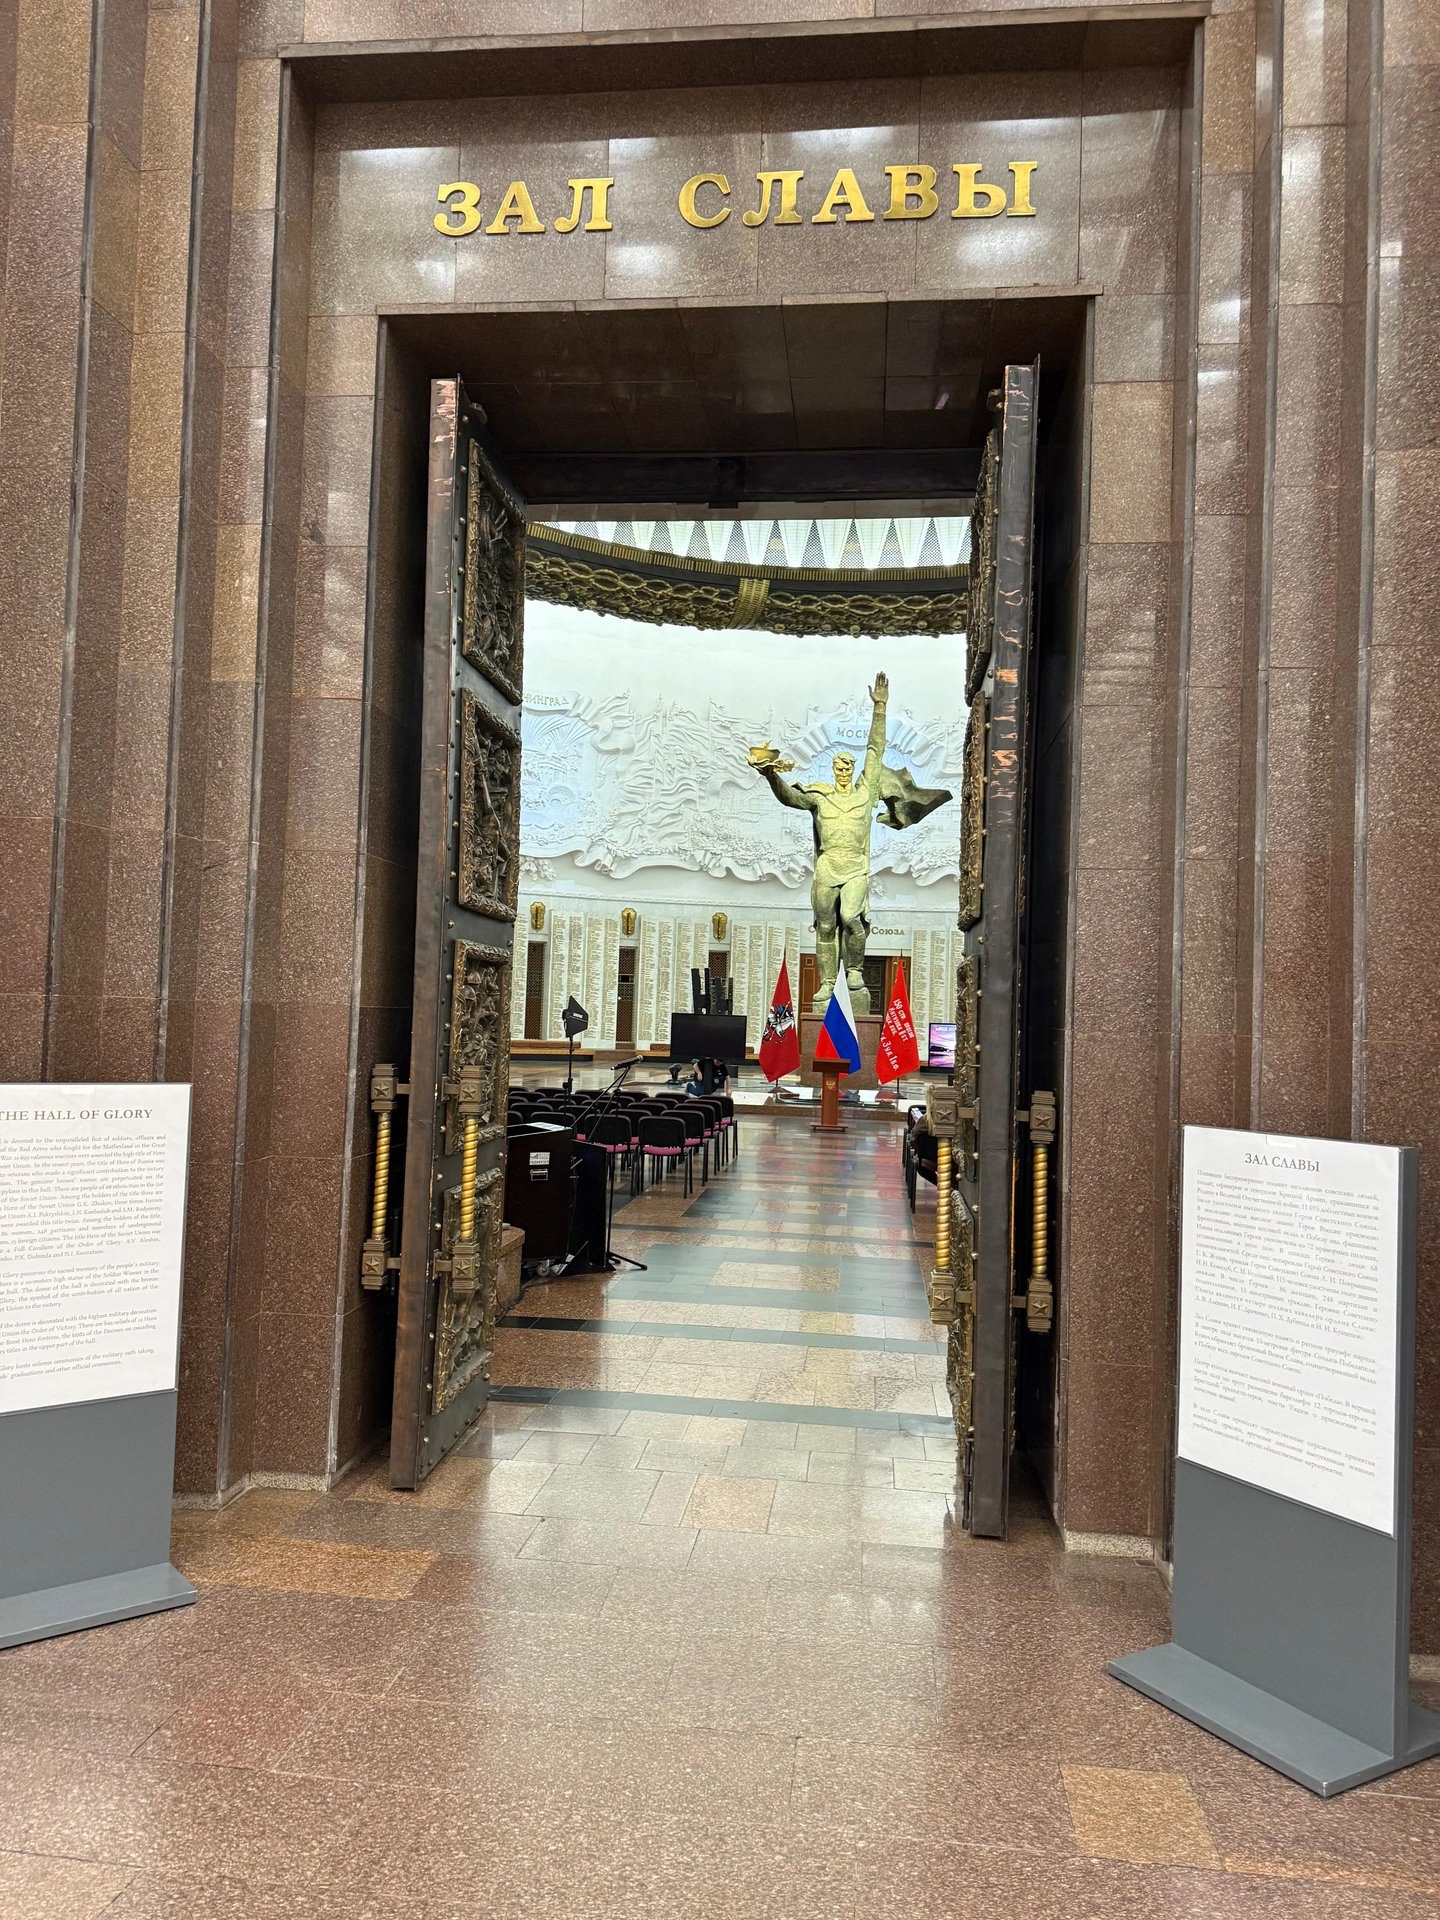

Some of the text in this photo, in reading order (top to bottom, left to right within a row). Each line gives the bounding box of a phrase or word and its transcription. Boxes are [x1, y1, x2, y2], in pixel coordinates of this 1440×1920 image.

[434, 160, 1038, 237] ЗАЛ СЛАВЫ
[893, 999, 903, 1010] 150
[0, 1109, 153, 1121] THE HALL OF GLORY
[1244, 1152, 1319, 1172] ЗАЛ СЛАВЫ
